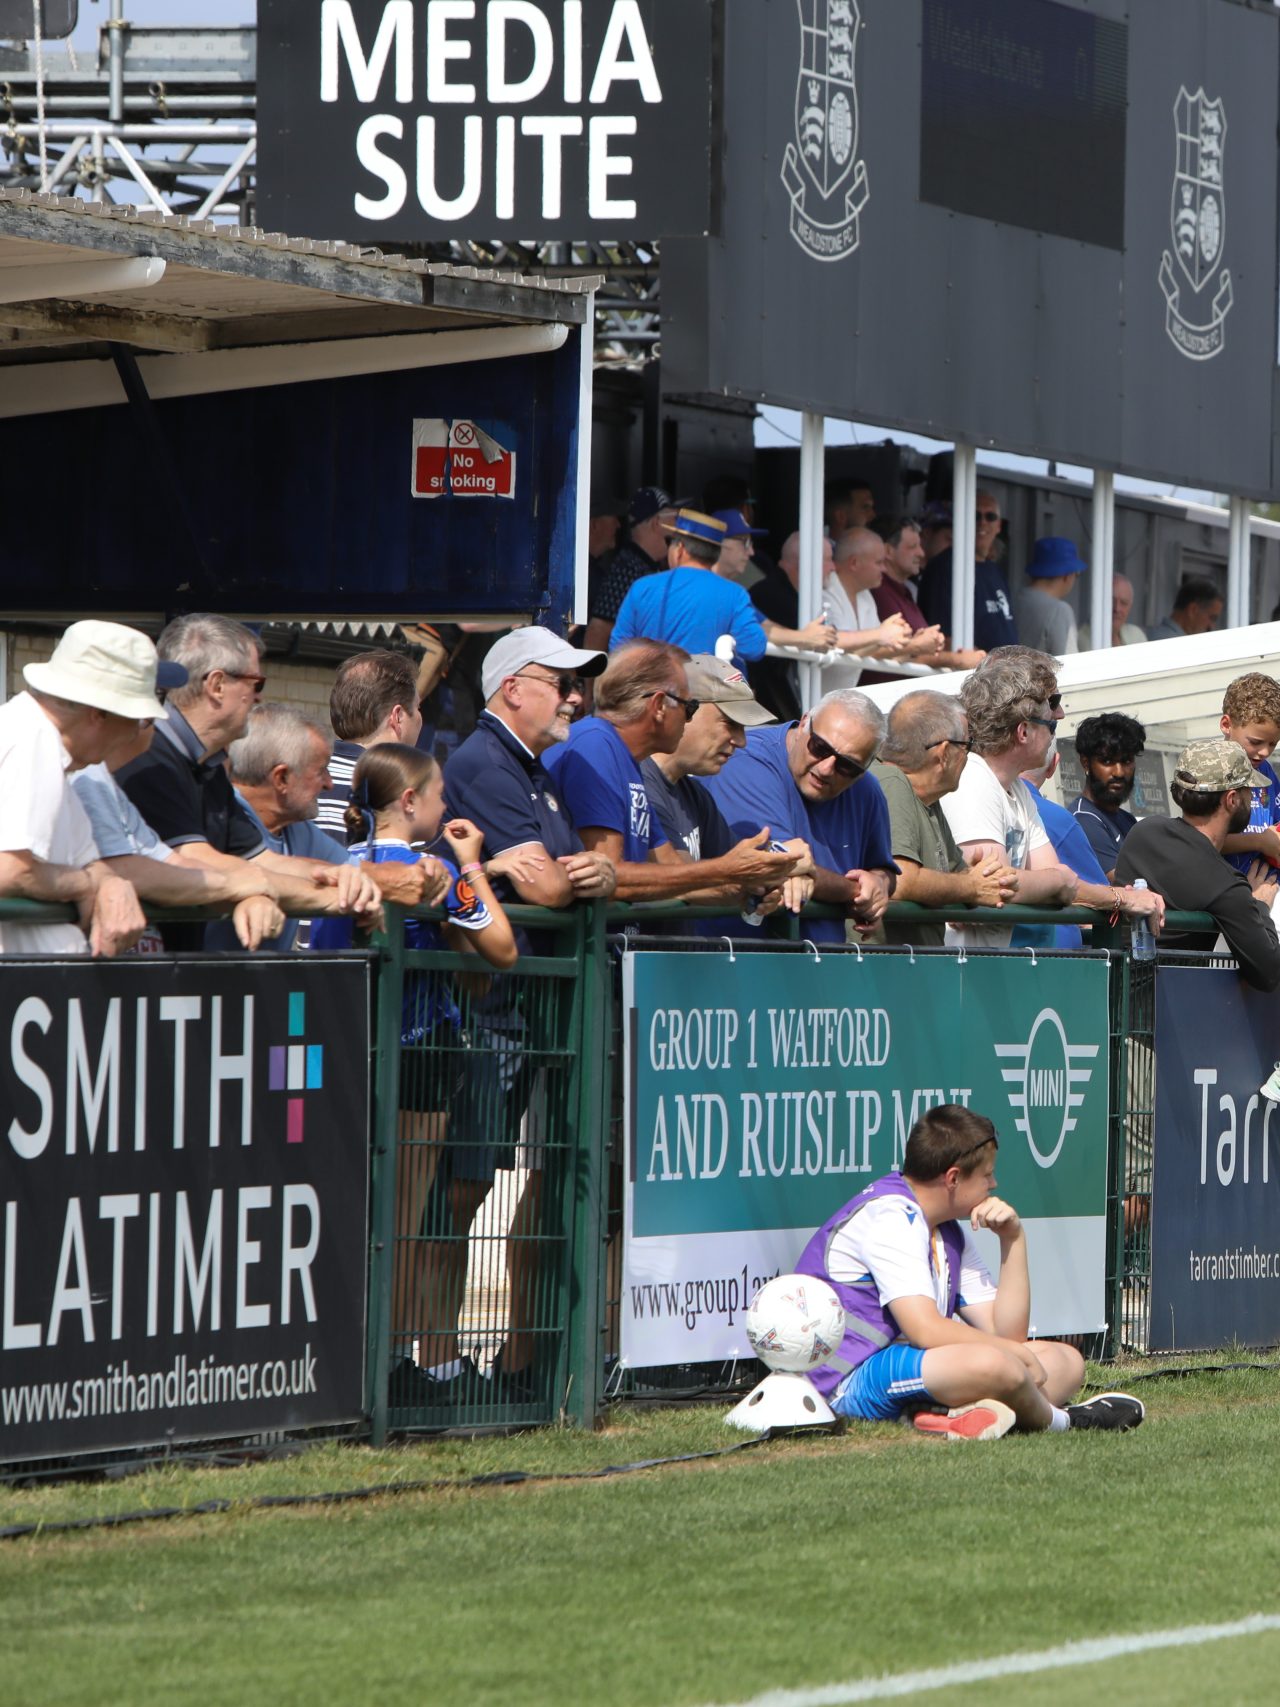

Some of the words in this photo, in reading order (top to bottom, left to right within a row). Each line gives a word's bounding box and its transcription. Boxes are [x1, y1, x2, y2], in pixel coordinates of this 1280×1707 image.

[320, 0, 663, 103] MEDIA
[354, 114, 637, 221] SUITE
[453, 453, 474, 468] No
[8, 995, 254, 1159] SMITH
[650, 1008, 738, 1071] GROUP
[747, 1008, 757, 1068] 1
[768, 1008, 890, 1068] WATFORD
[1030, 1069, 1064, 1107] MINI
[647, 1095, 729, 1181] AND
[739, 1090, 882, 1177] RUISLIP
[2, 1183, 321, 1350] LATIMER
[631, 1264, 780, 1330] www.group1
[1, 1343, 317, 1425] www.smithandlatimer.co.uk
